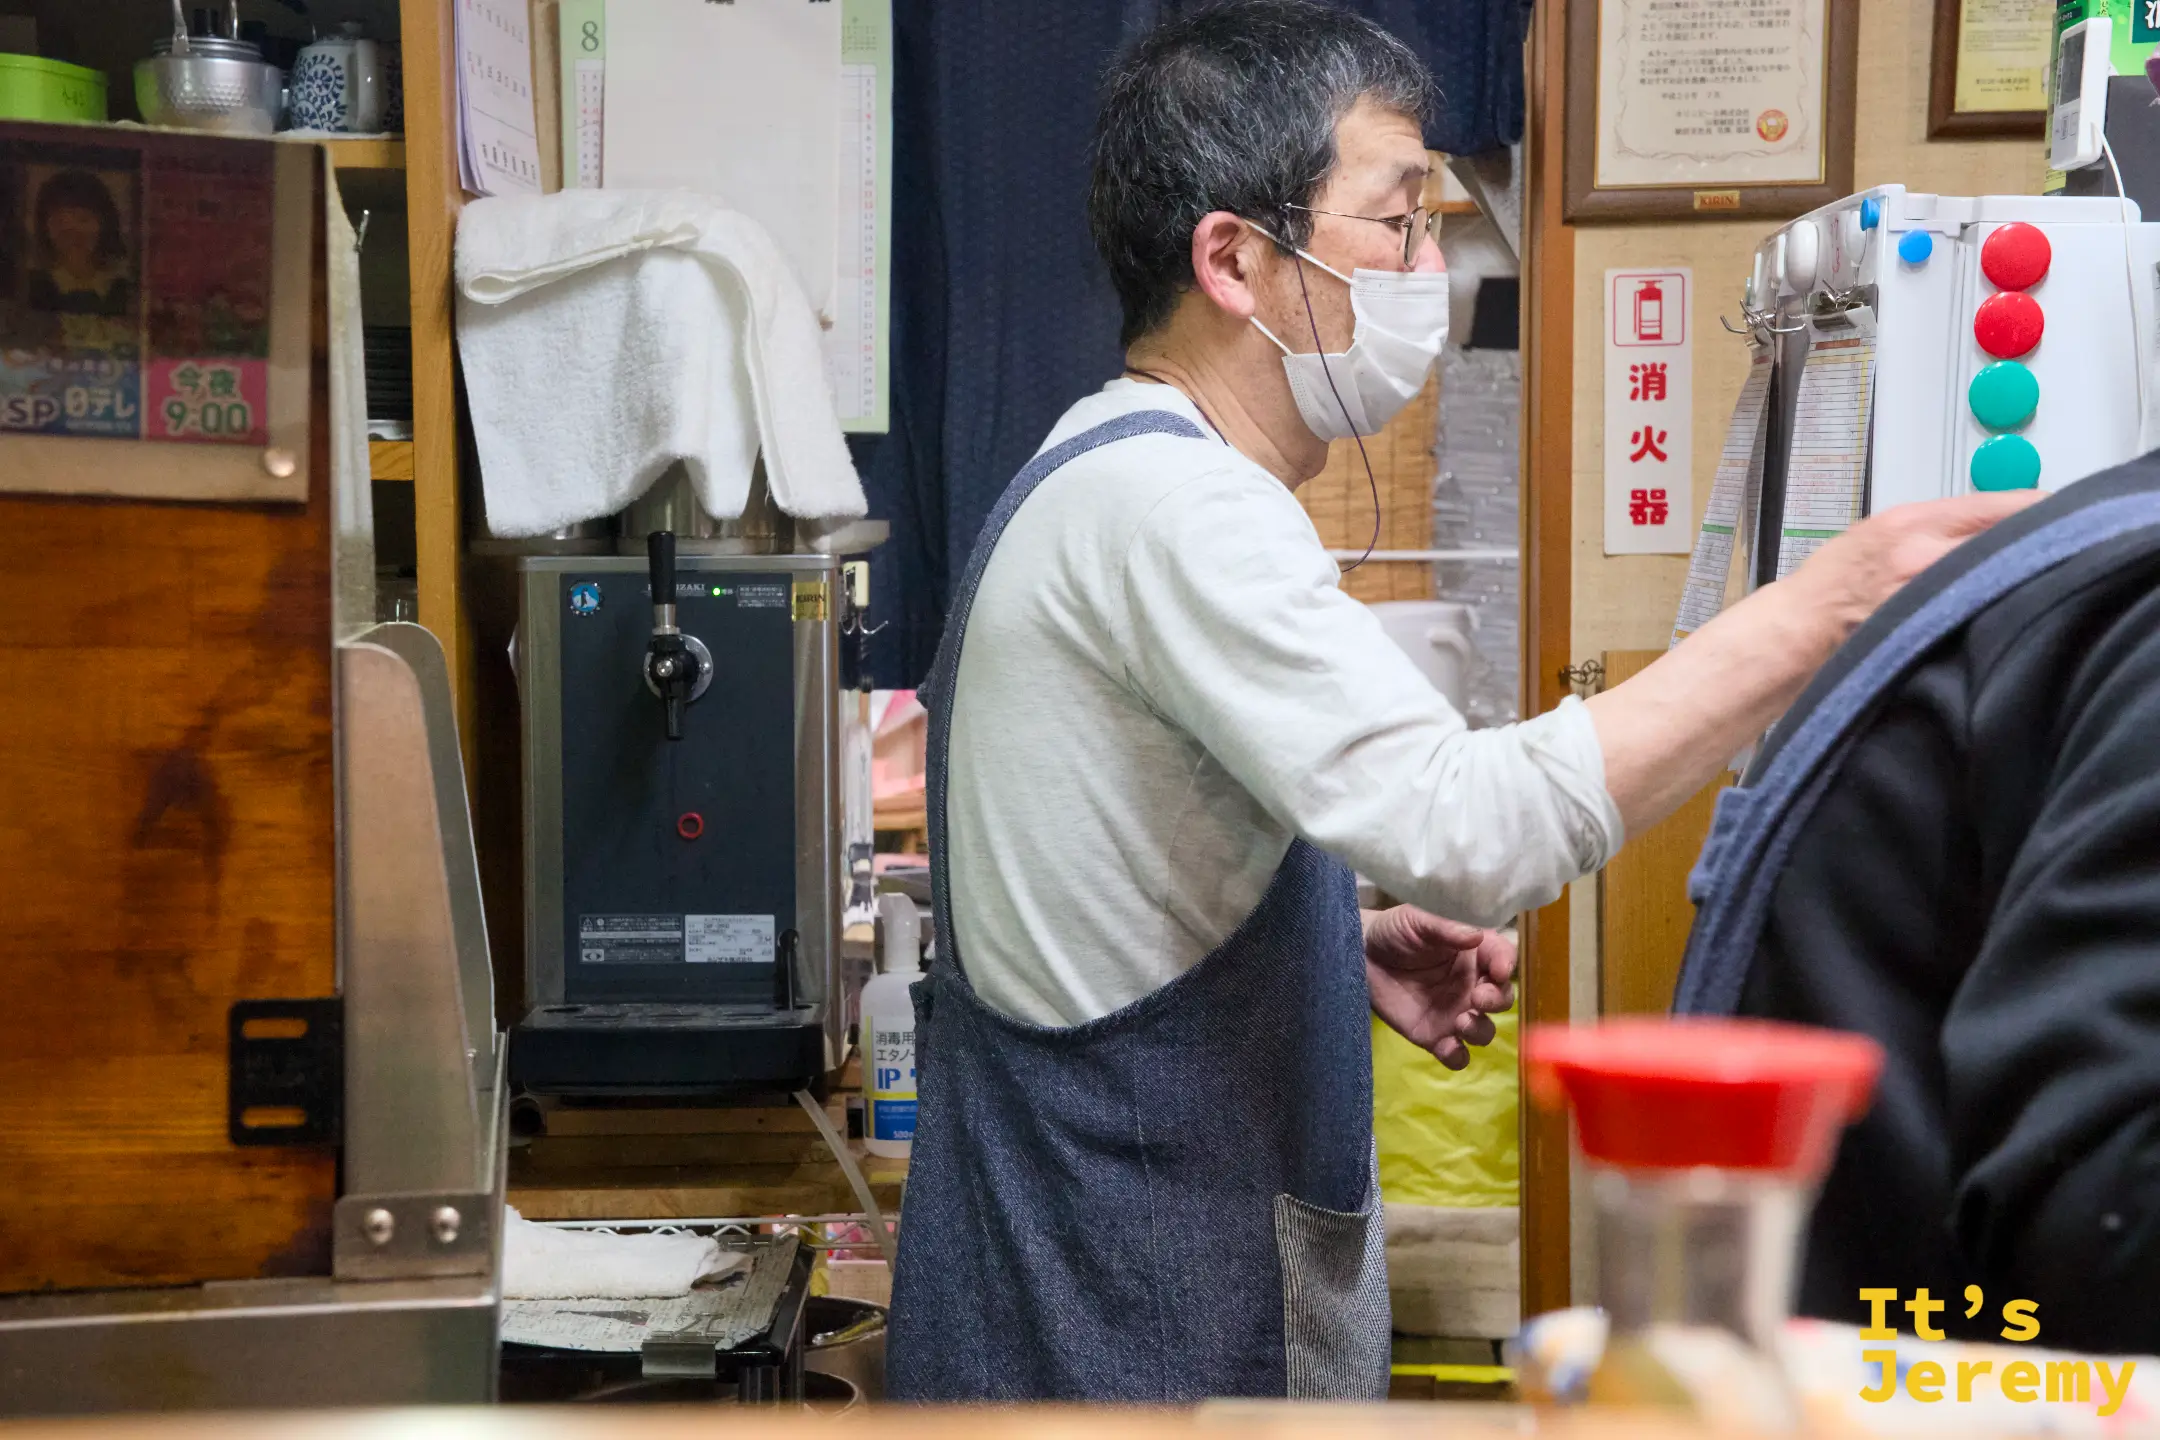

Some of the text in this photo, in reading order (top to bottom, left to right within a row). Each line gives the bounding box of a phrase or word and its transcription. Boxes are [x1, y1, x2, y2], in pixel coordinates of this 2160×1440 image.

[582, 20, 599, 51] 8
[1700, 196, 1734, 205] KIRIN
[176, 365, 237, 397] 今夜
[8, 397, 55, 424] SP
[65, 387, 135, 418] 日テレ
[166, 401, 248, 434] 9:00
[1629, 362, 1669, 526] 消火器
[878, 1068, 901, 1090] IP
